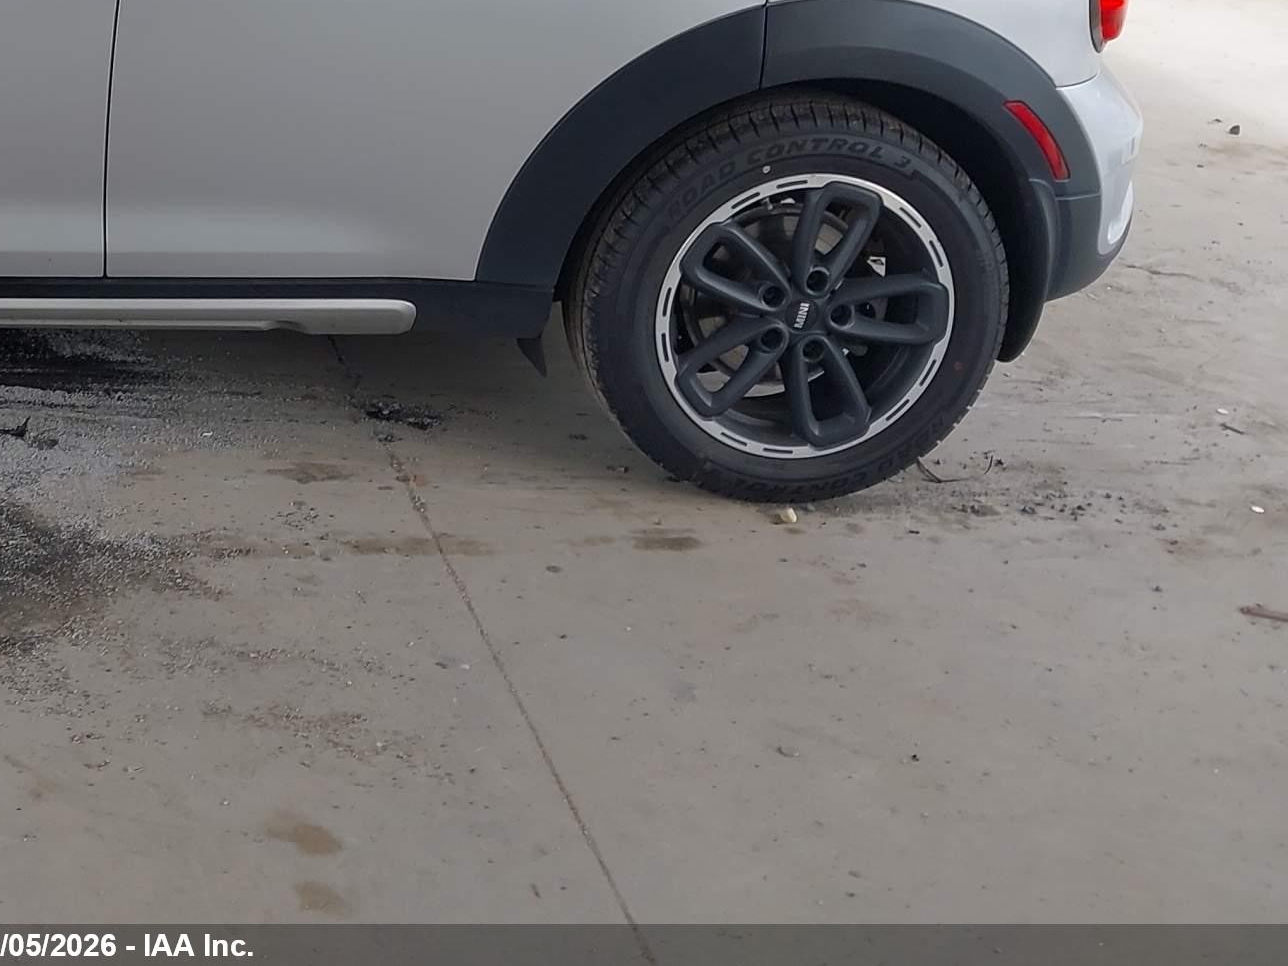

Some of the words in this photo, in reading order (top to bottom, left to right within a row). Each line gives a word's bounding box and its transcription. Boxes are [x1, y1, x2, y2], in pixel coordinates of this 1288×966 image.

[668, 160, 738, 219] ROAD
[746, 136, 885, 165] CONTROL
[893, 157, 911, 170] 3
[793, 302, 810, 329] MINI
